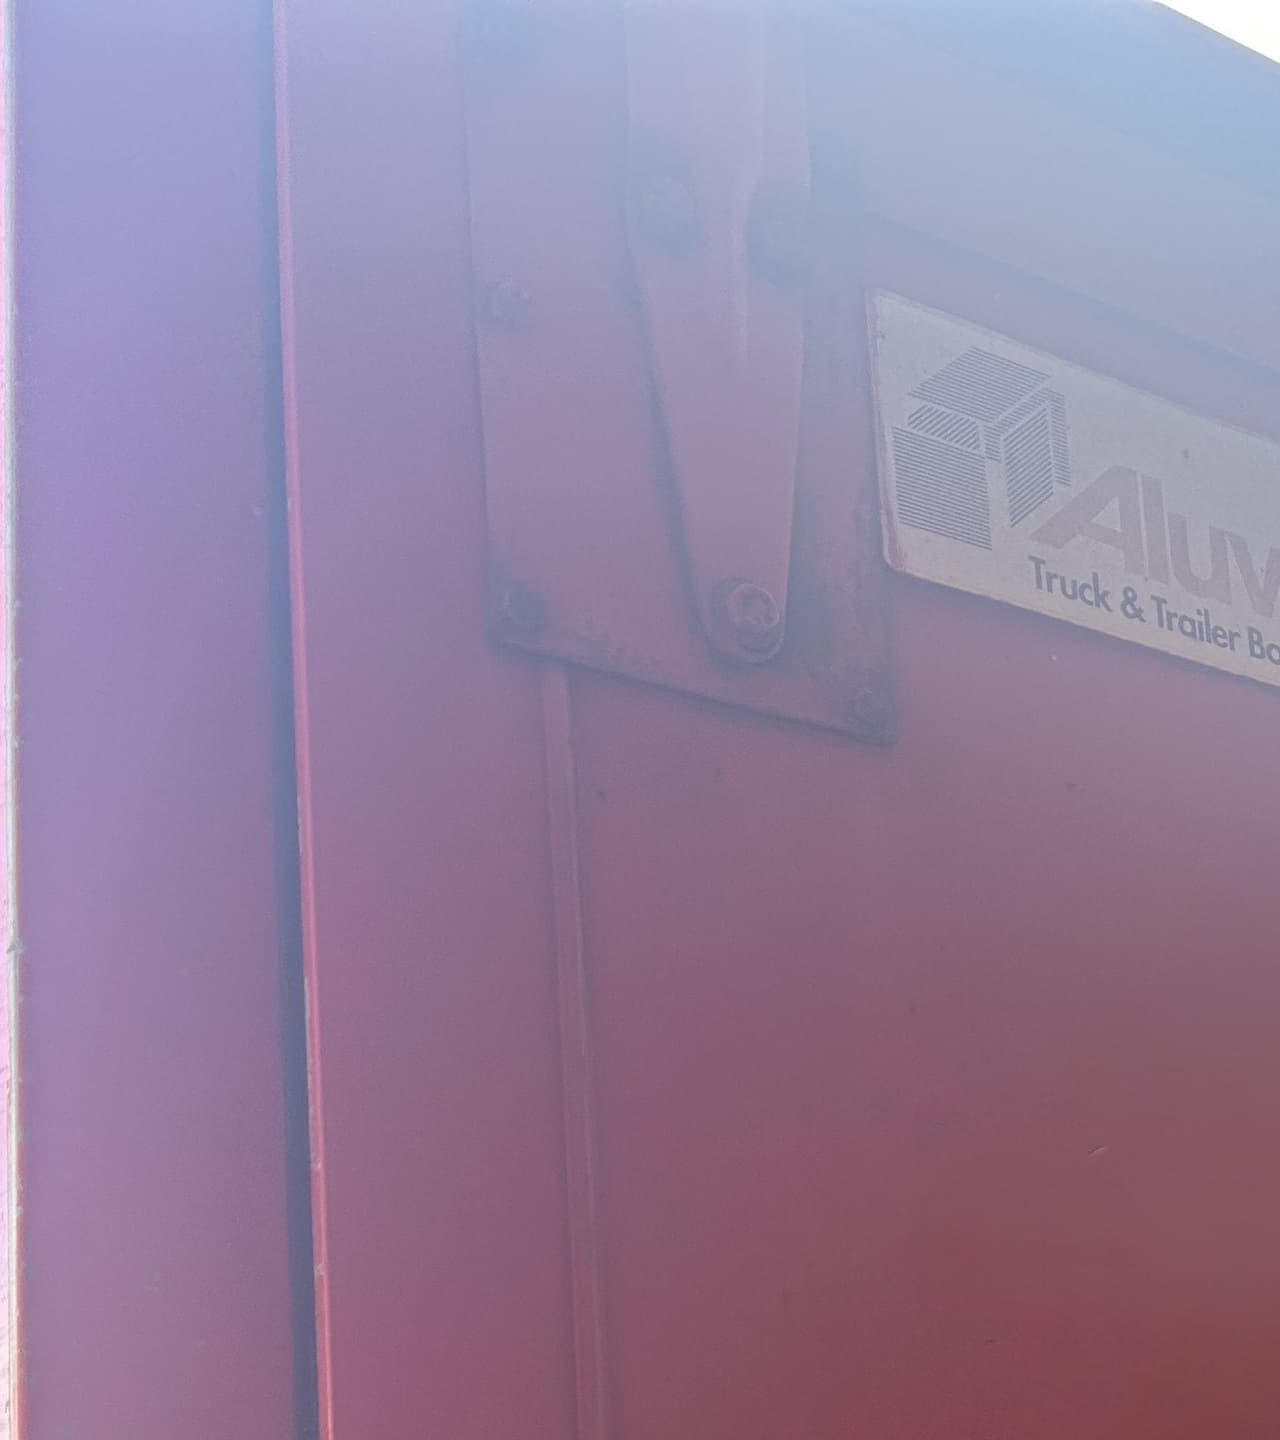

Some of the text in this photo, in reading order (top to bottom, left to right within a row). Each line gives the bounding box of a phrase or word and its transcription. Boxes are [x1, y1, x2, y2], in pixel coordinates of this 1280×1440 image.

[1028, 556, 1112, 612] Truck
[1120, 585, 1147, 622] &
[1151, 595, 1241, 651] Trailer
